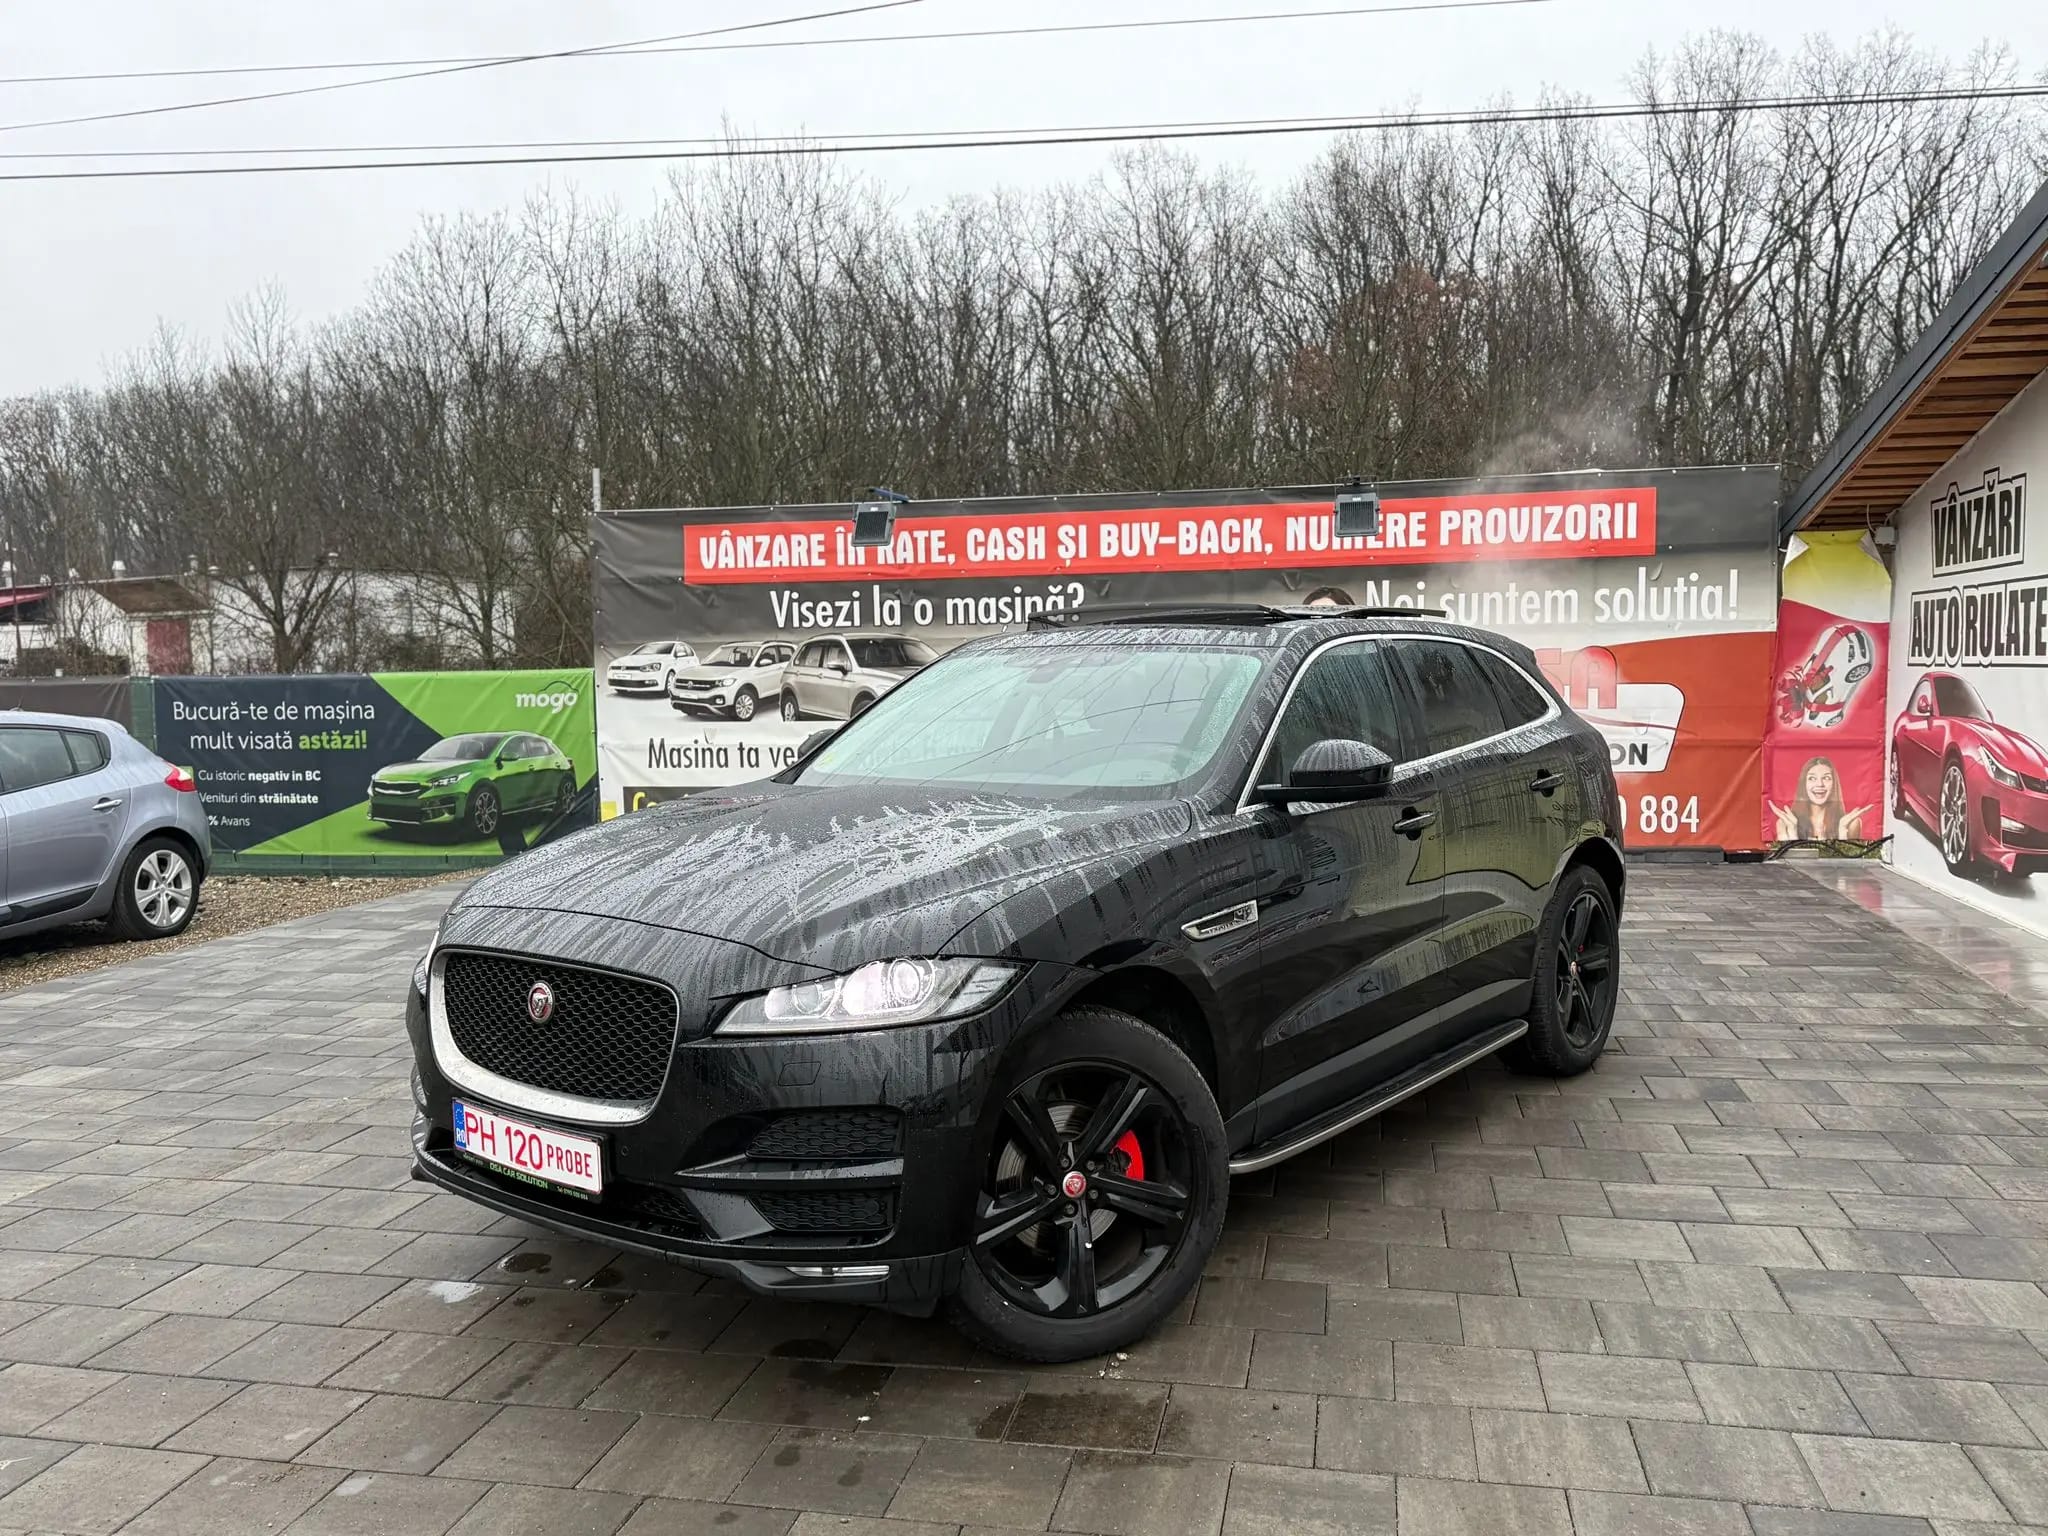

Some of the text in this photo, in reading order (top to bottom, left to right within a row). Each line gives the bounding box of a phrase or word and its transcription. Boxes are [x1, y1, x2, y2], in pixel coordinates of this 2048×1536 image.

[699, 529, 826, 569] VÂNZARE
[966, 525, 1046, 562] CASH
[1057, 524, 1087, 568] ȘI
[1099, 517, 1273, 558] BUY-BACK,
[1439, 502, 1638, 546] PROVIZORII
[1933, 478, 2022, 568] VÂNZĂRI
[769, 589, 861, 628] Visezi
[873, 584, 901, 626] la
[914, 598, 934, 625] o
[1440, 582, 1579, 625] suntem
[173, 700, 375, 724] Bucură-te de mașina
[515, 692, 577, 714] mogo
[190, 730, 367, 750] mult visată astăzi!
[648, 737, 729, 768] Masina
[737, 741, 760, 768] ta
[198, 770, 213, 781] Cu
[216, 770, 246, 781] istoric
[248, 770, 289, 784] negativ
[305, 770, 321, 781] BC
[200, 791, 319, 804] Venituri din străinătate
[221, 816, 250, 826] Avans
[1640, 794, 1700, 834] 884
[456, 1127, 465, 1143] RO
[465, 1112, 593, 1178] PH 120 PROBE
